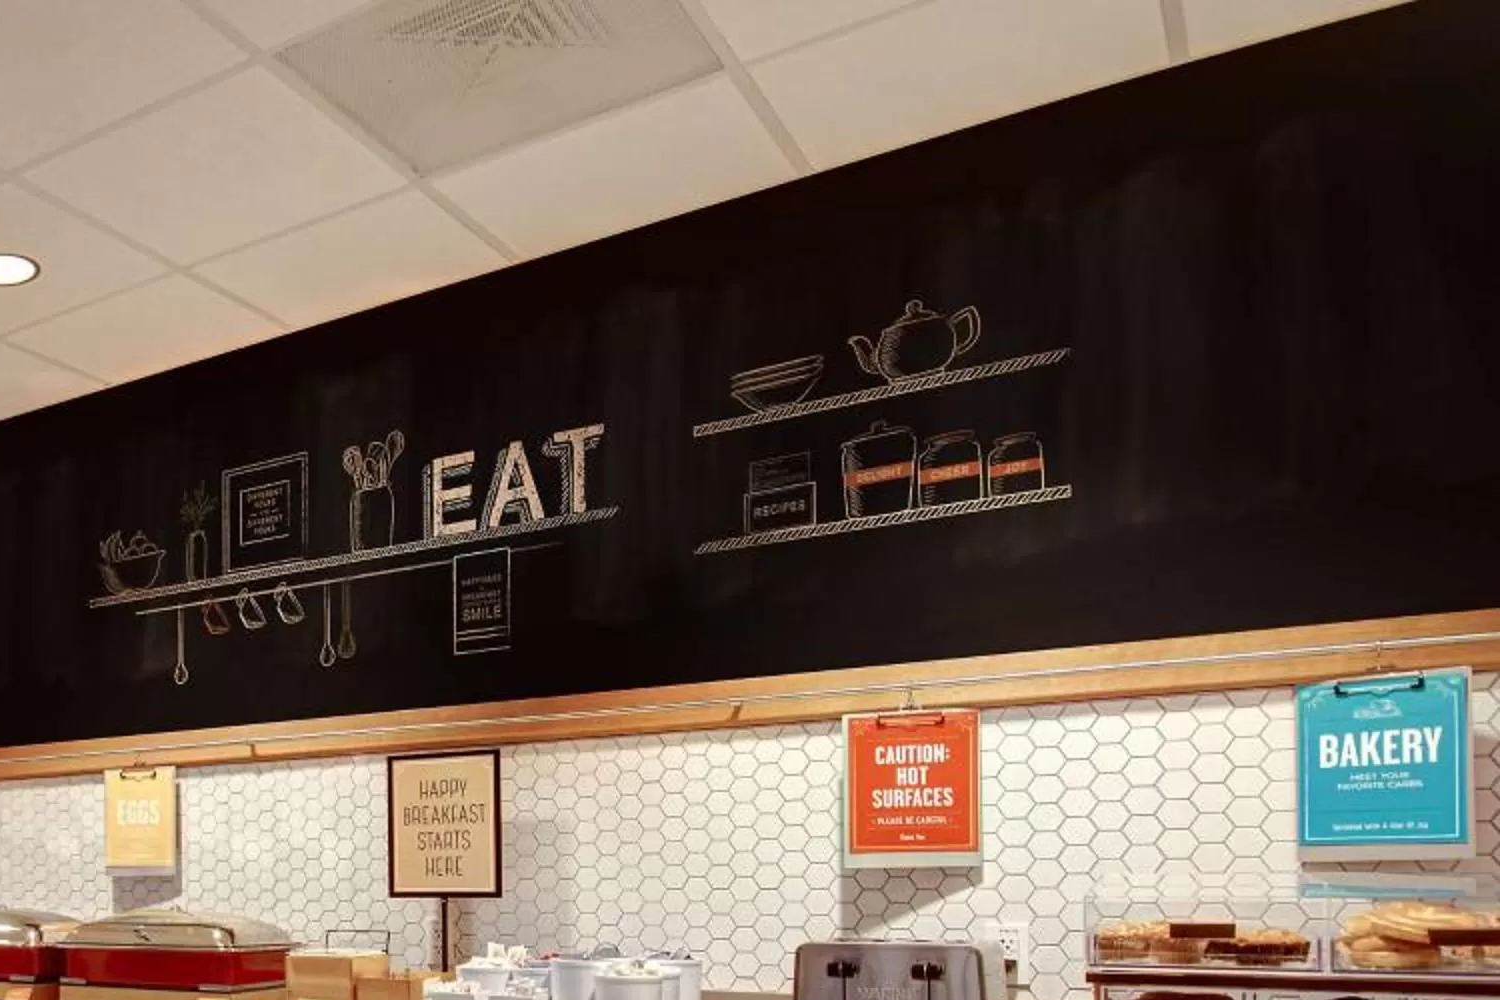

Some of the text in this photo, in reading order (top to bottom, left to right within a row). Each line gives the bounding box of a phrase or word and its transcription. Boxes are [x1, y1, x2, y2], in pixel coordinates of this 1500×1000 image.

[428, 423, 605, 538] EAT
[462, 605, 501, 622] SMILE
[875, 743, 951, 766] CAUTION:
[1319, 725, 1443, 769] BAKERY
[897, 765, 929, 786] HOT
[1349, 771, 1410, 782] MEET YOUR
[419, 778, 467, 801] HAPPY
[872, 786, 954, 809] SURFACES
[117, 799, 161, 826] EGGS
[403, 802, 485, 826] BREAKFAST
[417, 830, 471, 851] STARTS
[425, 855, 463, 877] HERE
